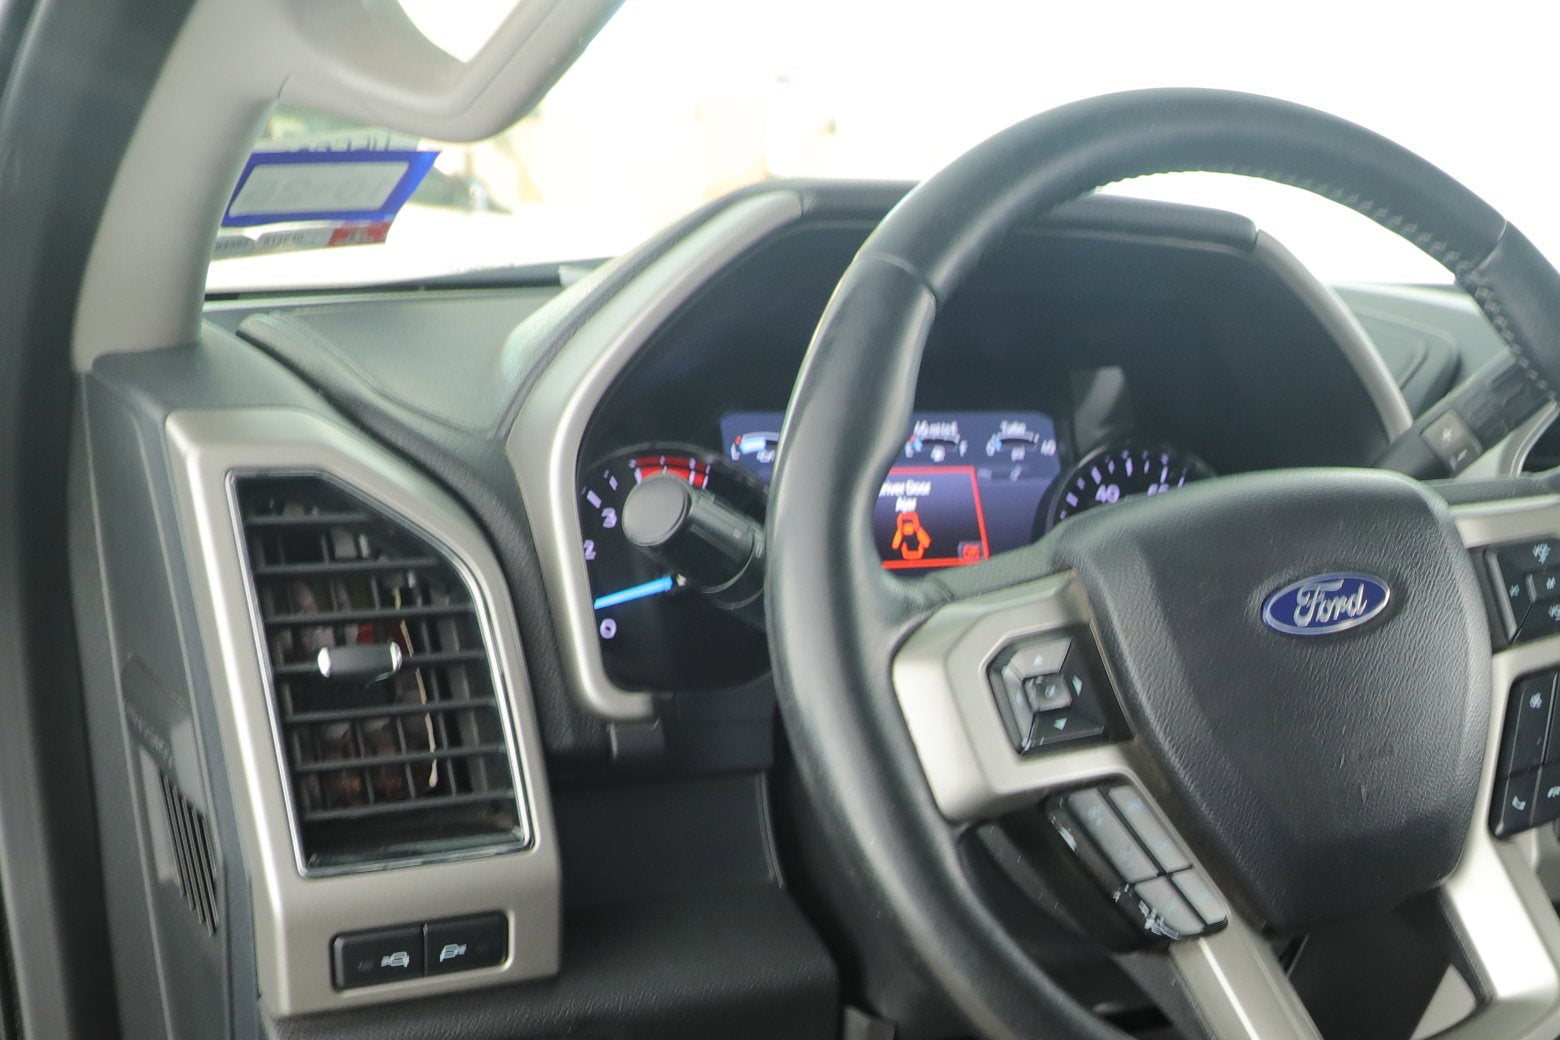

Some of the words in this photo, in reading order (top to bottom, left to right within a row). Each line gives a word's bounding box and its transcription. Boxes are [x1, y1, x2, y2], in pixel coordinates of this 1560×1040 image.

[1096, 484, 1120, 503] 40
[602, 508, 617, 528] 3
[584, 540, 597, 560] 2
[1294, 578, 1367, 627] Ford
[600, 618, 617, 639] 0
